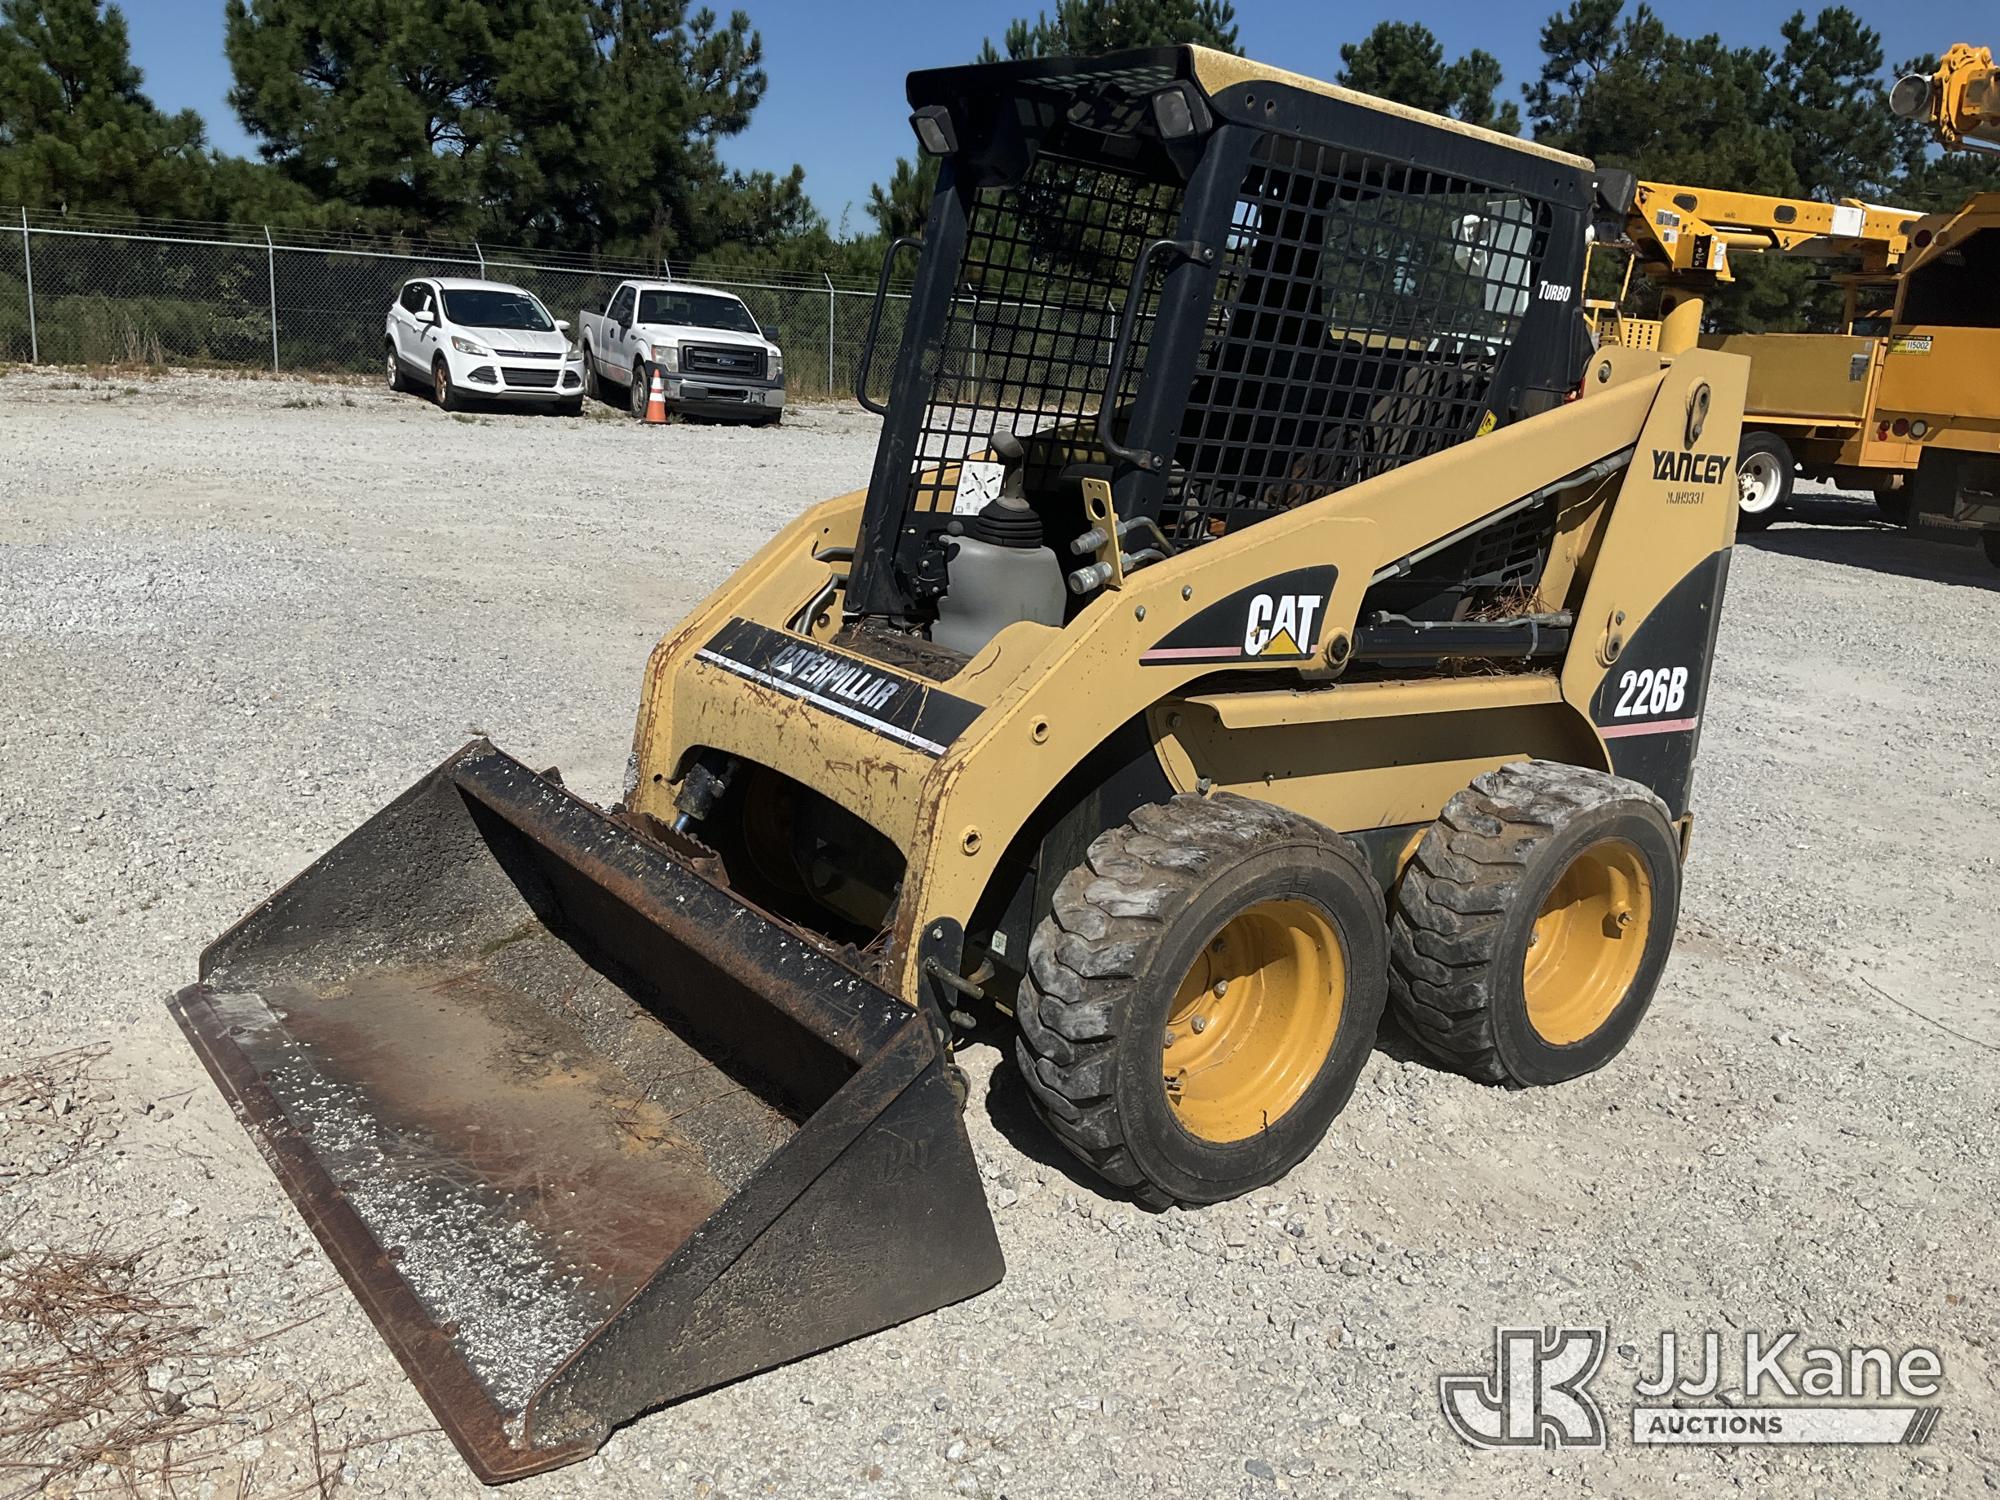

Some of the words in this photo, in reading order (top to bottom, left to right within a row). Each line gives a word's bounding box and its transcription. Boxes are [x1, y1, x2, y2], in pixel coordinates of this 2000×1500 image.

[1538, 280, 1572, 302] TURBO
[1652, 449, 1732, 485] YANCEY
[1244, 593, 1321, 656] CAT
[770, 644, 900, 711] CATERPILLAR
[1613, 666, 1689, 717] 226B
